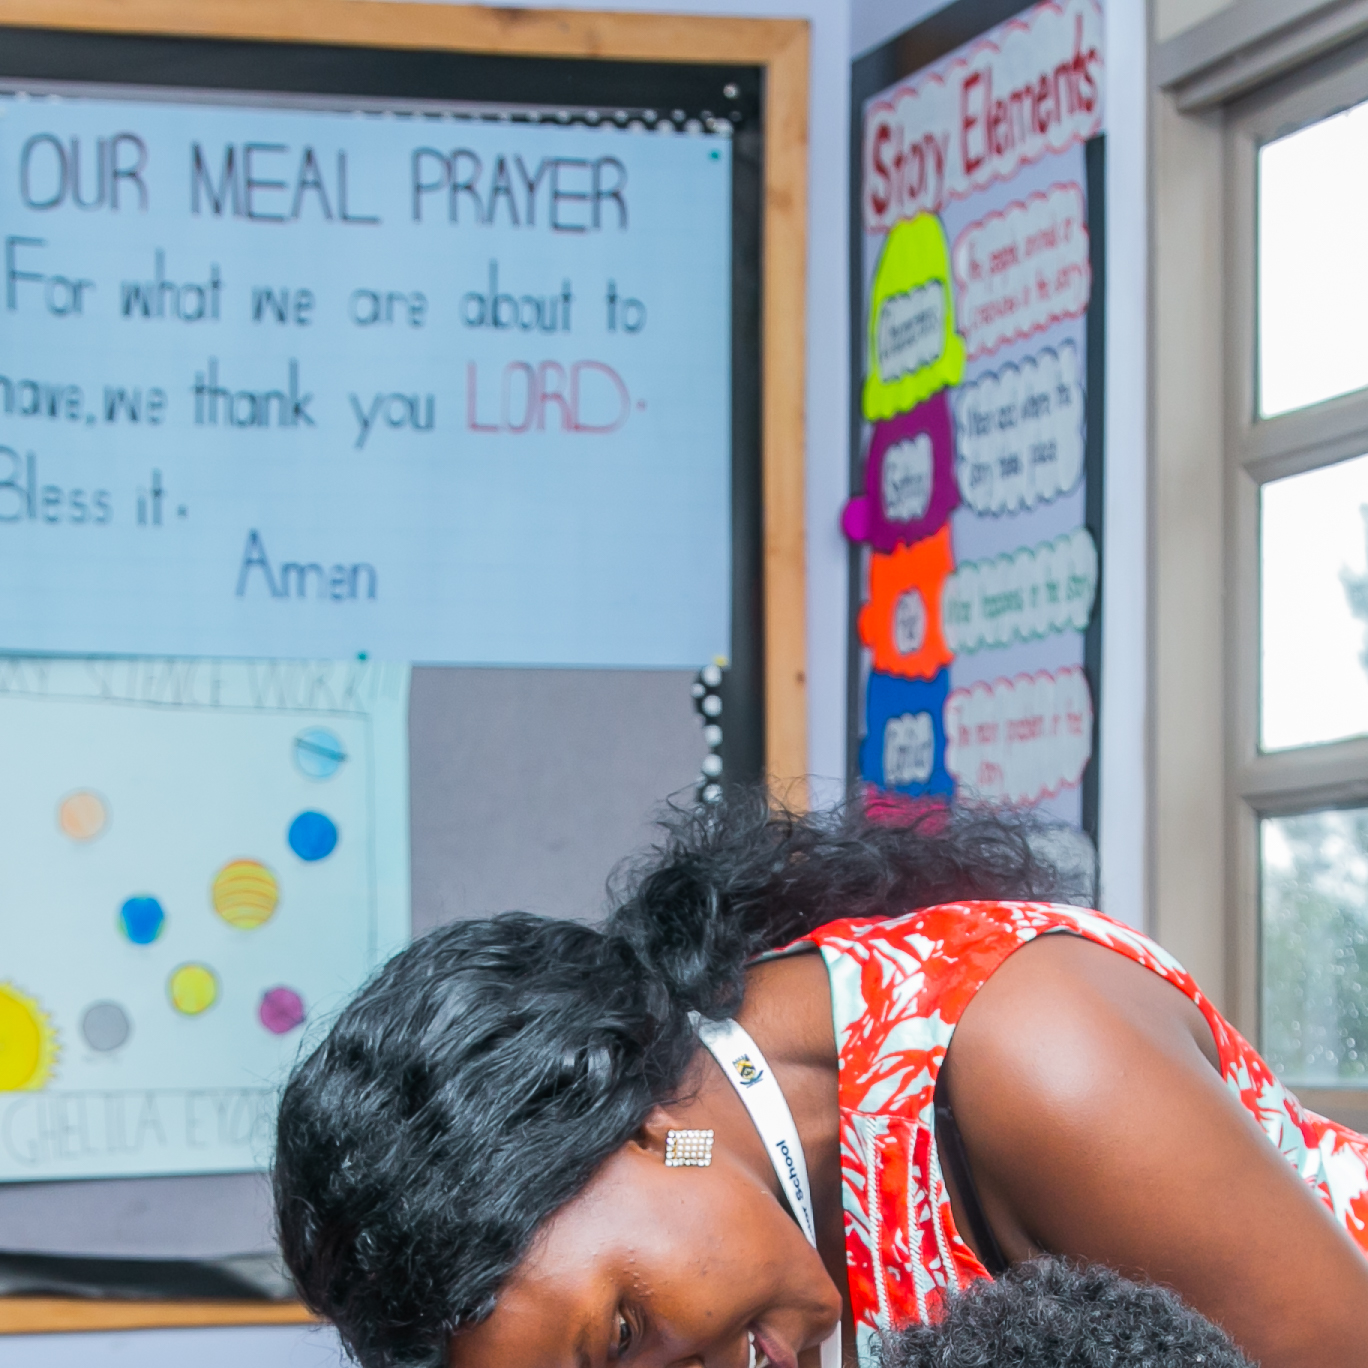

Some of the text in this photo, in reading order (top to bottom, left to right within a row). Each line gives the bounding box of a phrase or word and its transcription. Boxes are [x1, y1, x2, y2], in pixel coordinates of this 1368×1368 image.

[960, 12, 1098, 174] Elements
[18, 131, 630, 232] OUR MEAL PRAYER
[4, 235, 647, 334] For what we are about to
[191, 357, 315, 430] thank
[350, 387, 436, 449] you
[236, 529, 377, 601] Amen
[776, 1140, 804, 1201] School
